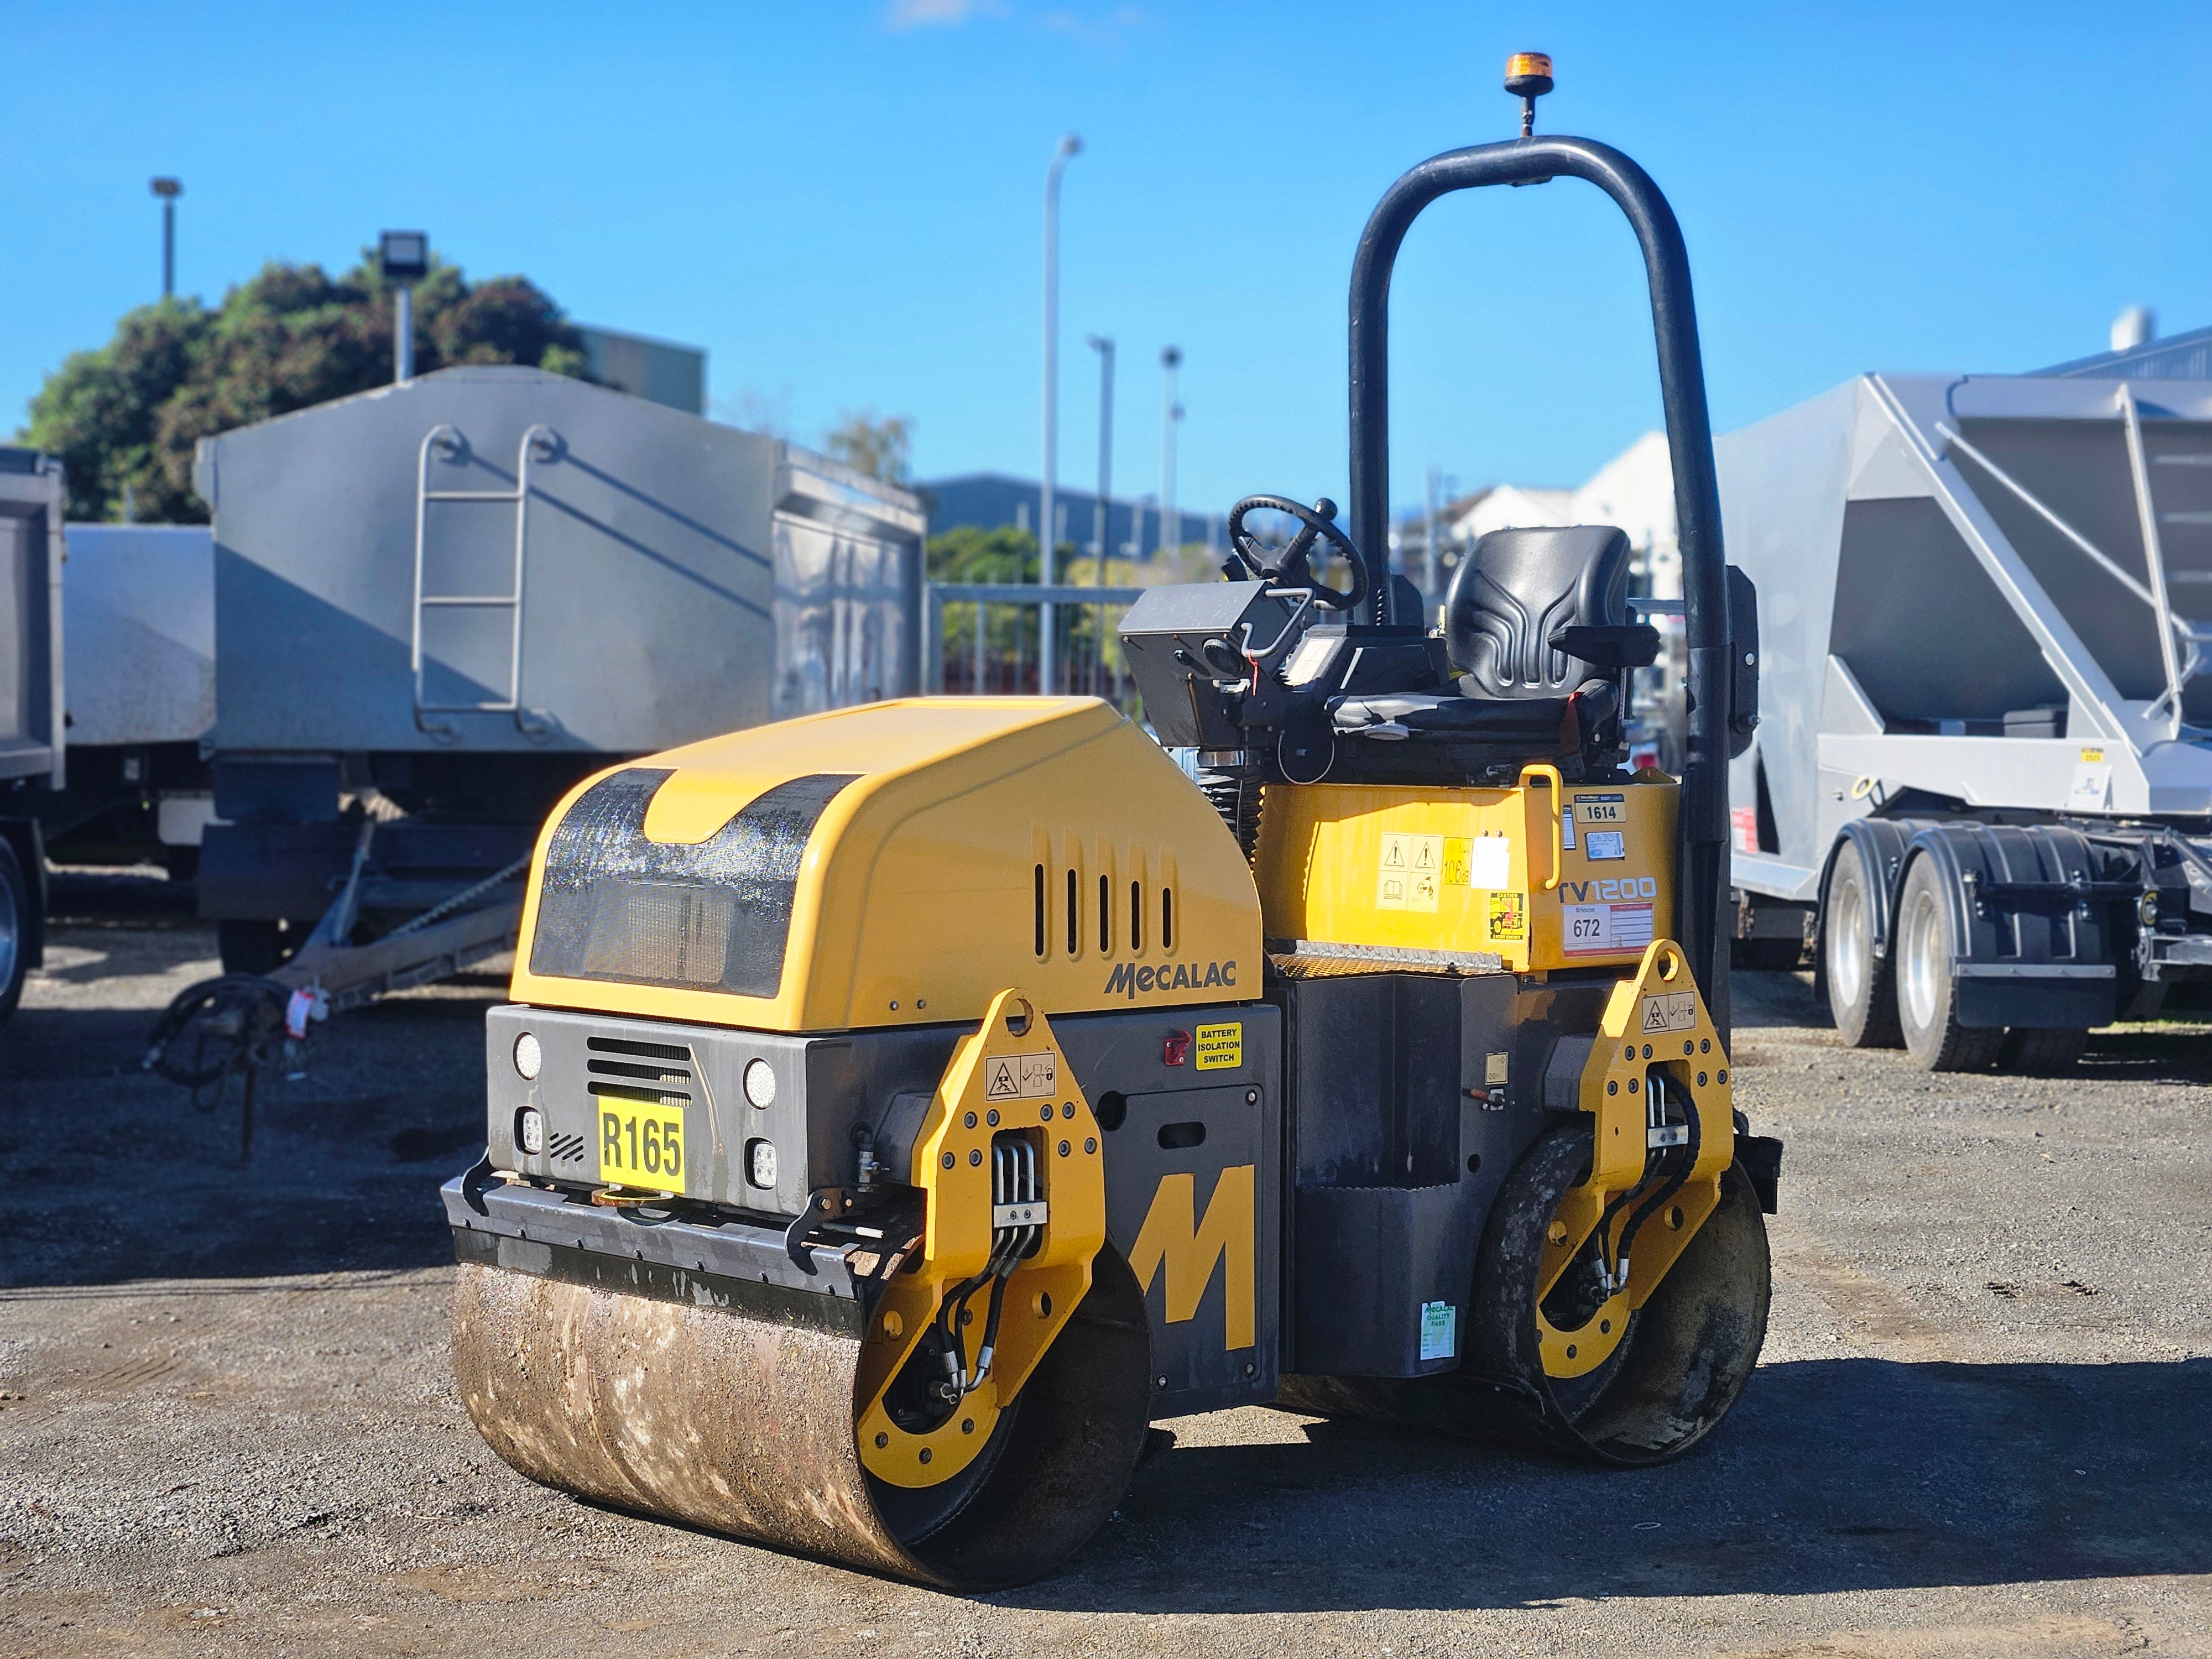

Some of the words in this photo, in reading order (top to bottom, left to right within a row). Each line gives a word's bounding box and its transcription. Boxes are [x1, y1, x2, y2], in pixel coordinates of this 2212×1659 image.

[1587, 806, 1616, 819] 1614
[1573, 919, 1600, 937] 672
[1201, 1028, 1238, 1039] BATTERY
[1197, 1041, 1240, 1051] ISOLATION
[1203, 1053, 1235, 1064] SWITCH
[602, 1112, 681, 1177] R165
